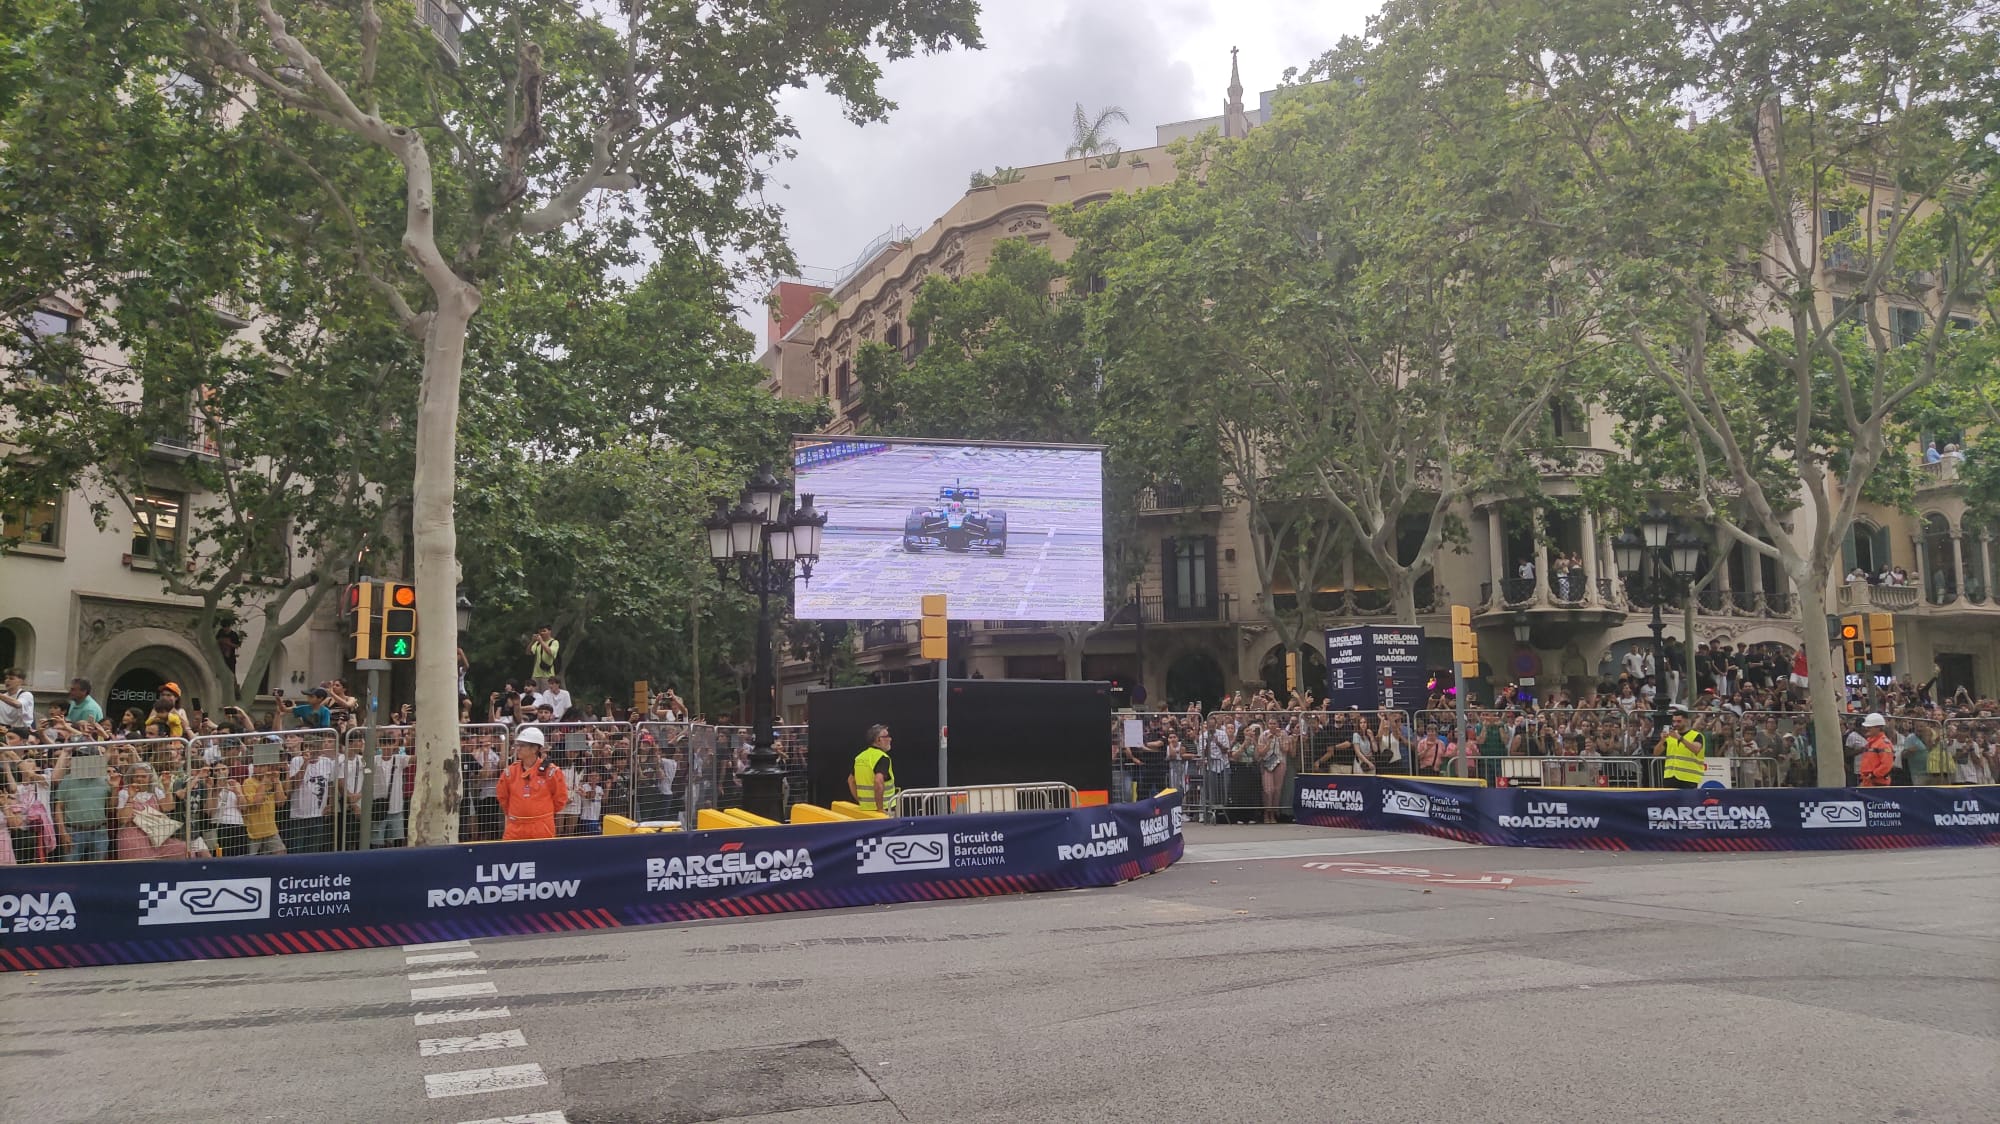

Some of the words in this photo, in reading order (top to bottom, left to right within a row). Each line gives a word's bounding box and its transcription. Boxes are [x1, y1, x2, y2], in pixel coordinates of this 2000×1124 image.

[1329, 634, 1362, 644] BARCELONA
[1332, 656, 1362, 664] ROADSHOW
[1301, 788, 1364, 802] BARCELONA
[1302, 800, 1315, 808] FAN
[1346, 802, 1364, 811] 2024
[1528, 802, 1568, 814] LIVE
[1867, 801, 1891, 810] Circuit
[1647, 806, 1770, 820] BARCELONA
[1868, 810, 1901, 819] Barcelona
[1934, 812, 2000, 826] ROADSHOW
[1498, 815, 1600, 829] ROADSHOW
[1648, 820, 1676, 830] FAN
[1678, 820, 1738, 830] FESTIVAL
[1740, 820, 1772, 830] 2024
[953, 831, 990, 844] Circuit
[991, 830, 1004, 841] de
[954, 844, 1004, 856] Barcelona
[1058, 836, 1128, 860] ROADSHOW
[646, 848, 813, 878] BARCELONA
[954, 856, 1006, 867] CATALUNYA
[476, 862, 536, 883] LIVE
[647, 876, 683, 892] FAN
[686, 871, 767, 889] FESTIVAL
[769, 866, 814, 882] 2024
[278, 874, 330, 890] Circuit
[333, 874, 351, 886] de
[278, 889, 351, 904] Barcelona
[428, 880, 581, 908] ROADSHOW
[278, 904, 351, 918] CATALUNYA
[13, 914, 76, 933] 2024
